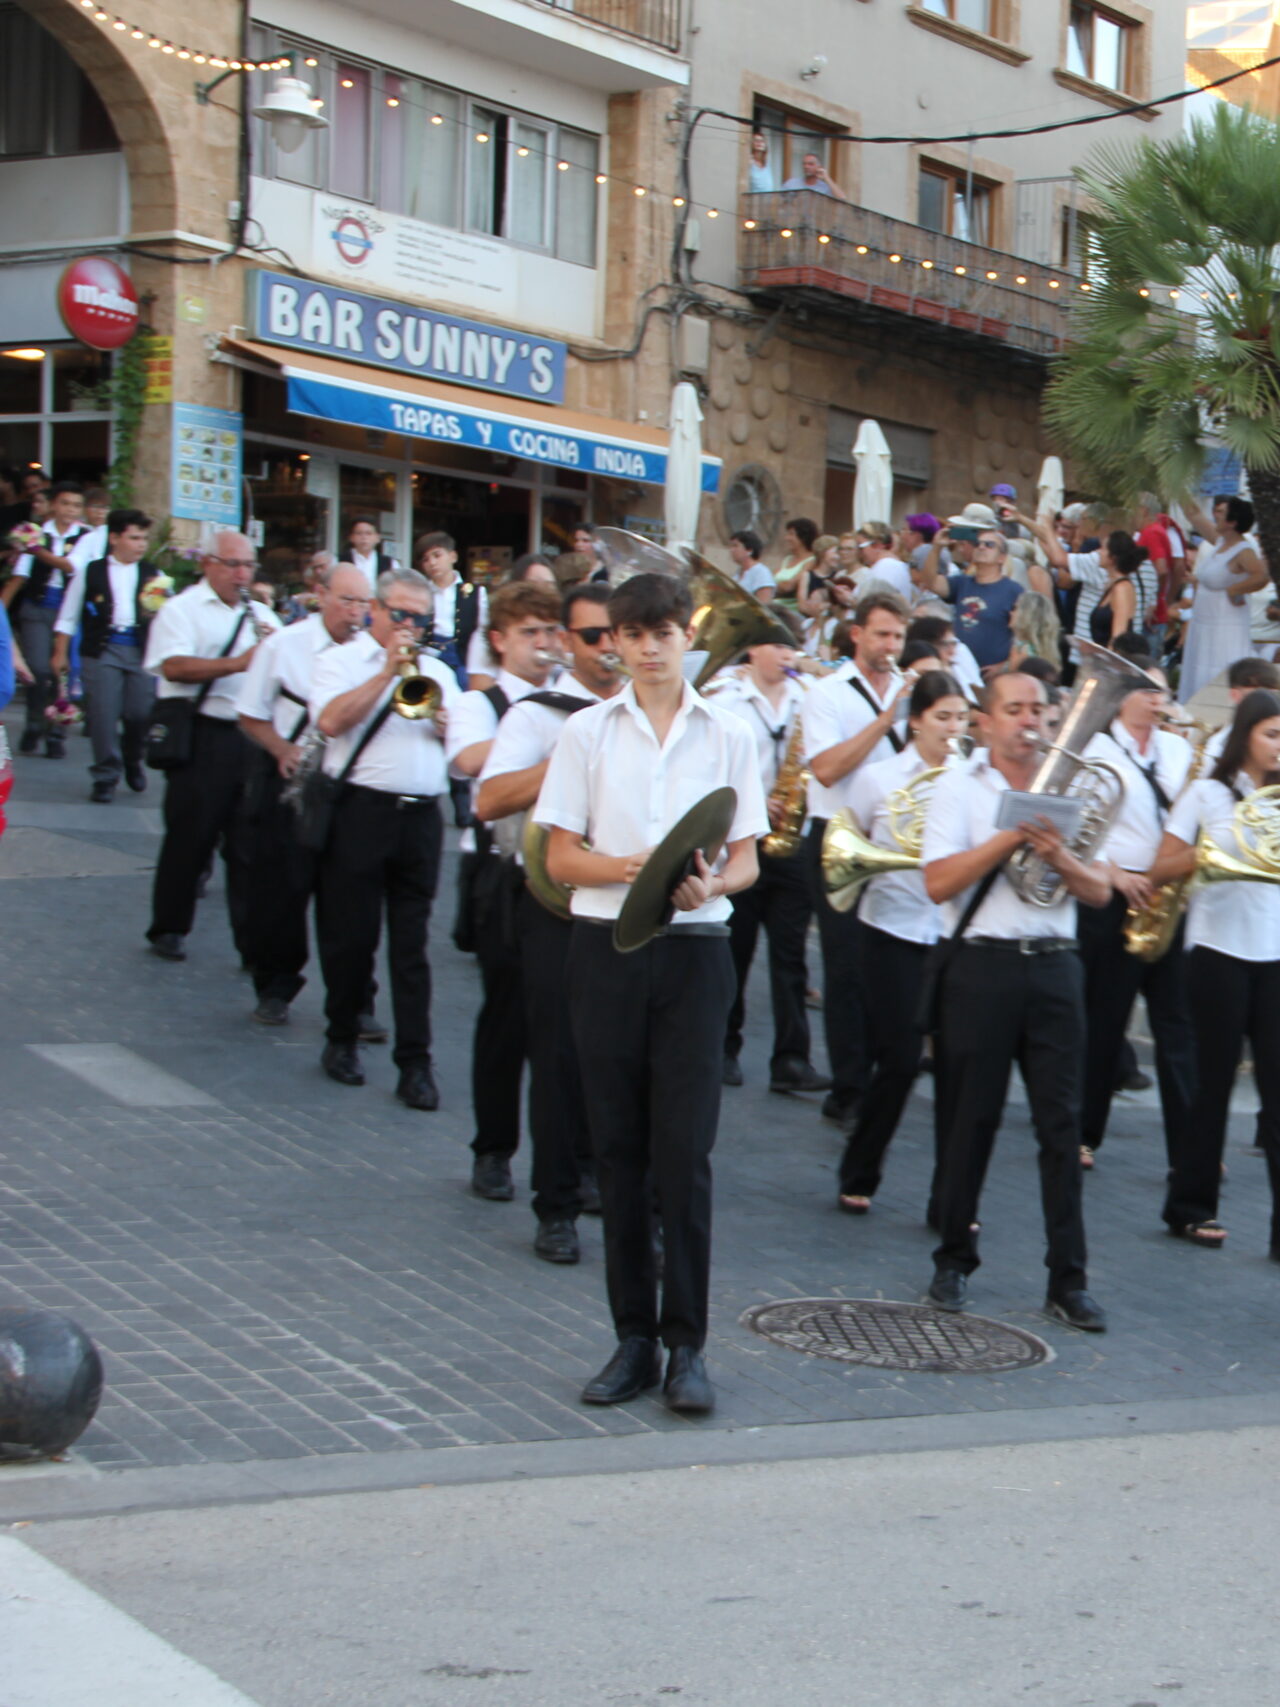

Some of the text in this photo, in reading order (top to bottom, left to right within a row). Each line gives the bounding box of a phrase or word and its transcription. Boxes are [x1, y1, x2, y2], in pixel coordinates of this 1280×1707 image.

[356, 206, 386, 236] Stop
[270, 283, 554, 394] BAR SUNNY'S
[390, 403, 646, 477] TAPAS Y COCINA INDIA
